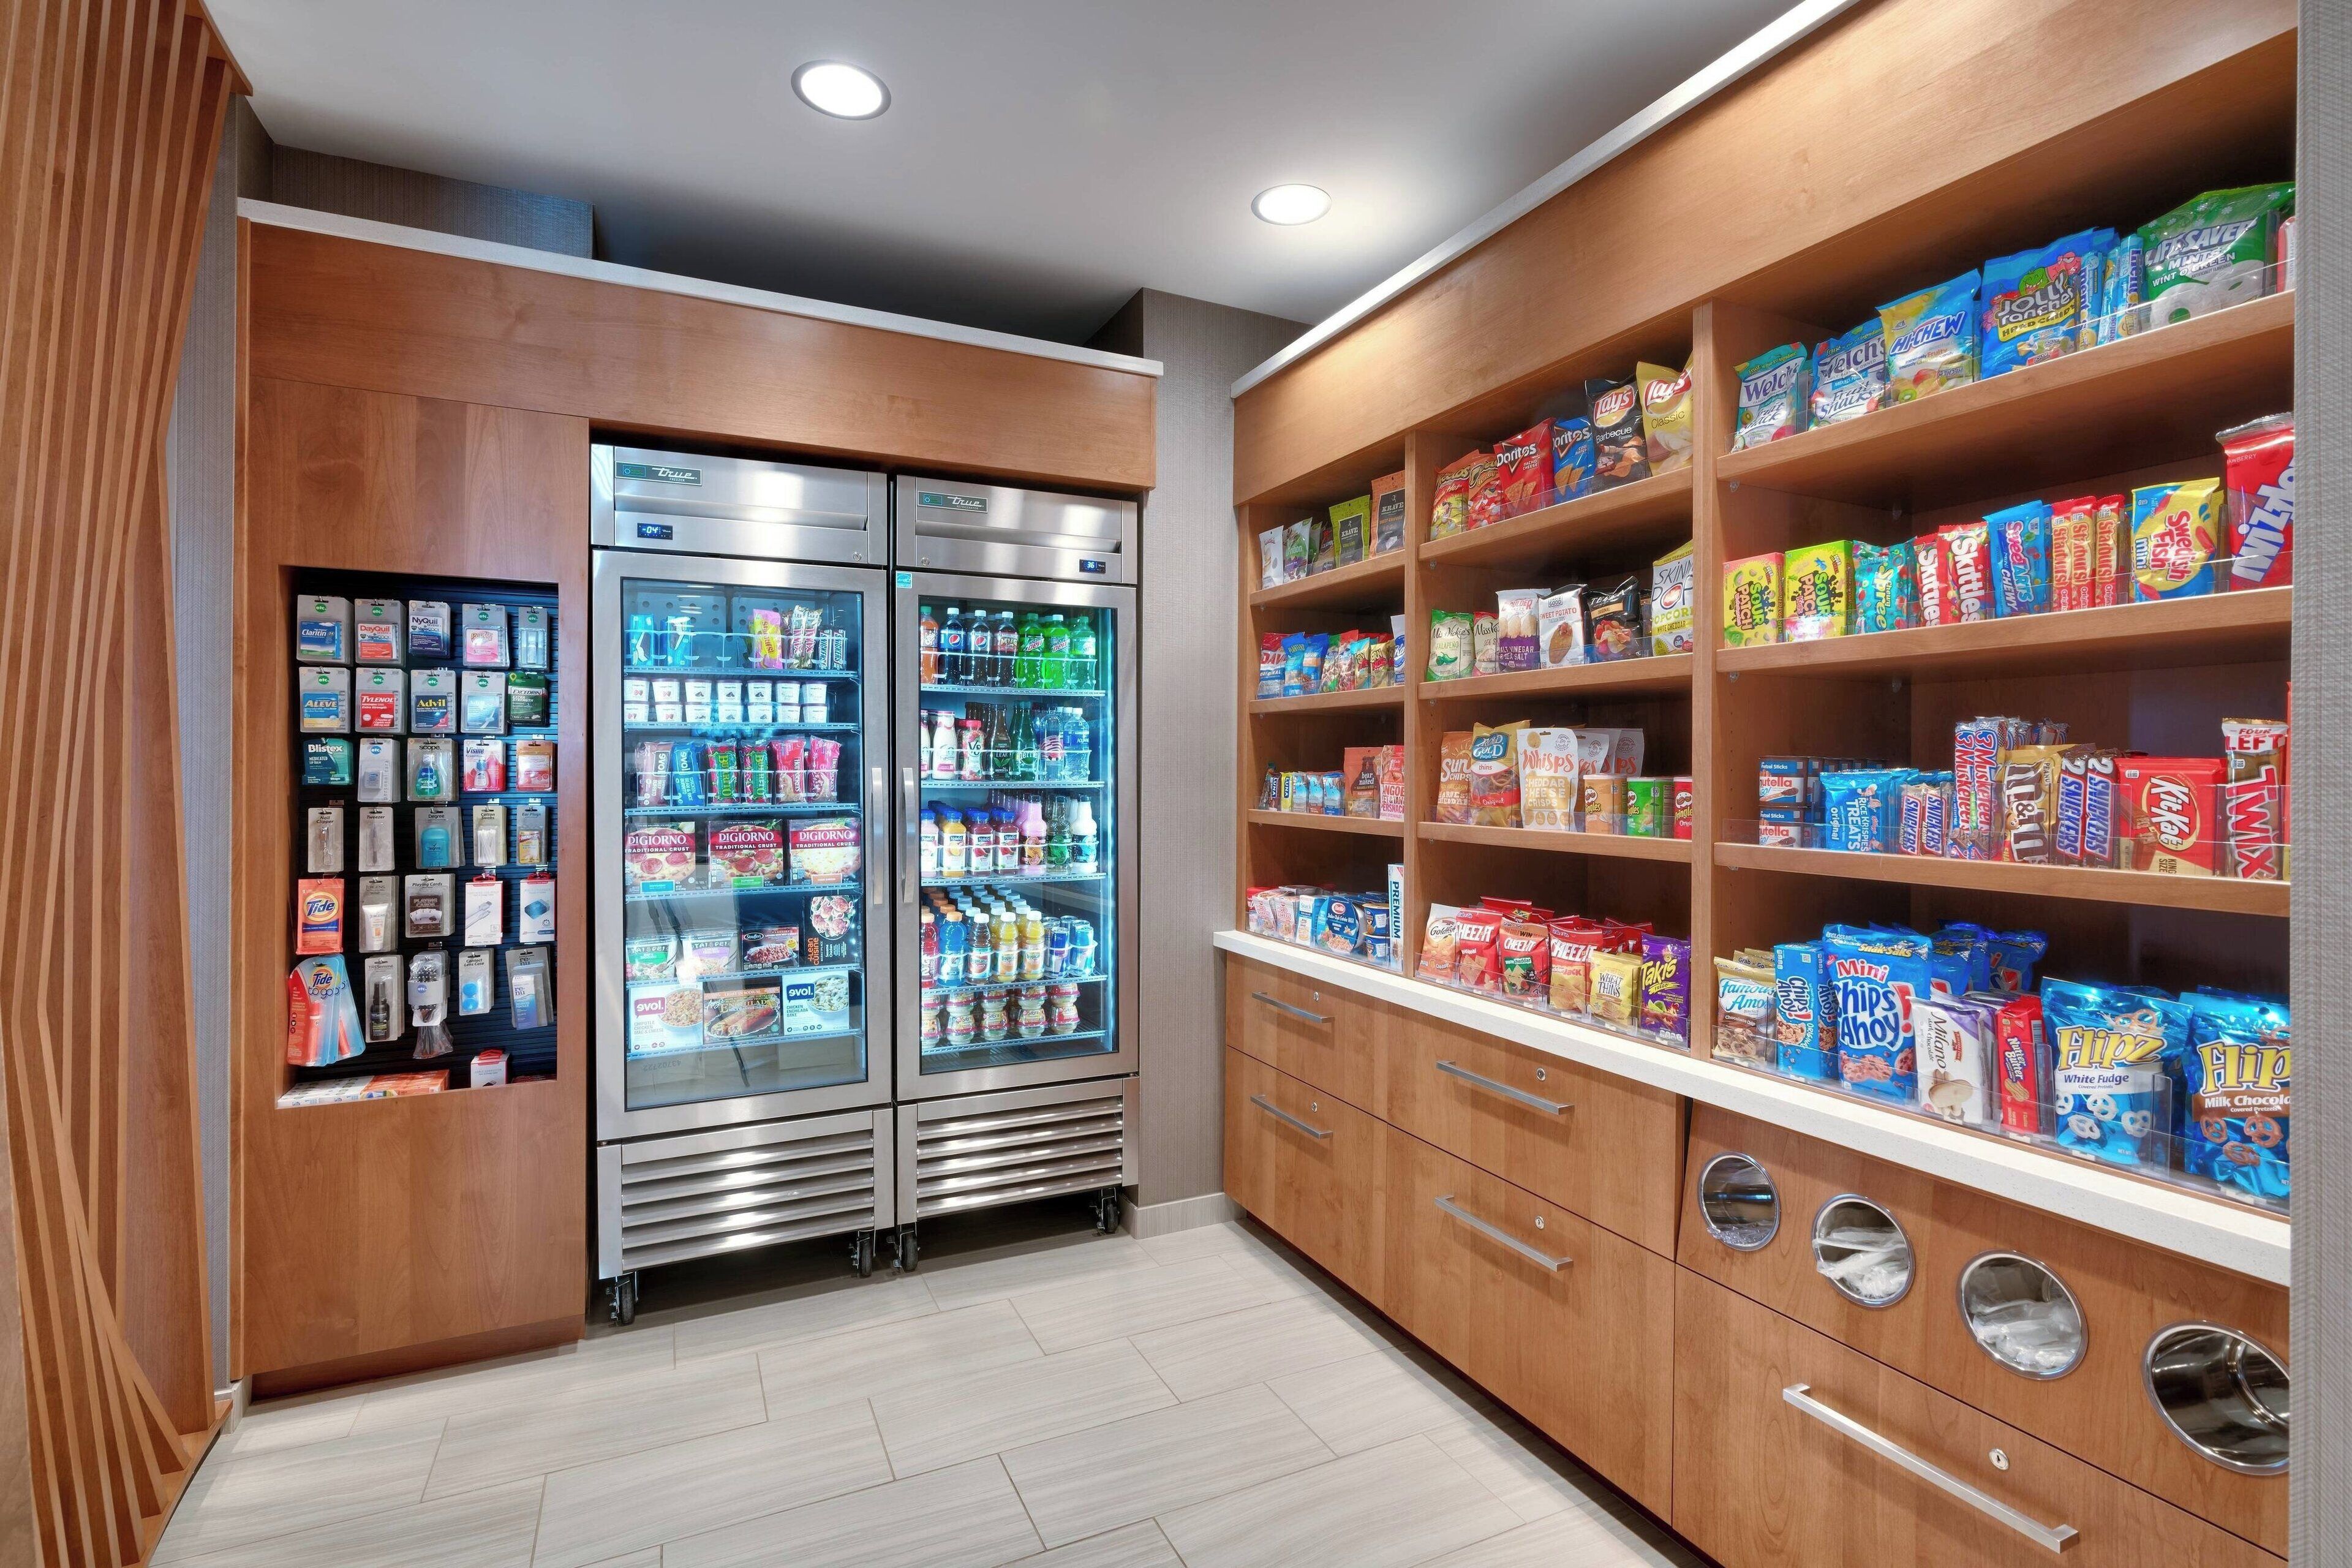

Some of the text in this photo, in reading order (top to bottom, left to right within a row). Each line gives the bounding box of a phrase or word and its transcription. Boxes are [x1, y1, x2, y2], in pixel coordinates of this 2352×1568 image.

[2153, 268, 2188, 287] WINT O
[1999, 272, 2065, 316] JOLLY
[1890, 311, 1967, 355] HI-CHEW
[1820, 337, 1886, 379] Welch's
[1833, 380, 1870, 402] Fruit
[1595, 391, 1632, 420] Lay's
[1651, 411, 1685, 429] Classic
[1596, 427, 1632, 444] Barbecue
[1496, 443, 1536, 467] Doritos
[1382, 502, 1404, 512] KRAVE
[1341, 527, 1358, 537] KRAVE
[2136, 538, 2149, 570] mini
[2150, 527, 2171, 570] Fish
[2166, 510, 2192, 582] Swedish
[1950, 537, 1981, 623] Skittles
[2001, 568, 2019, 611] CHEWY
[1736, 584, 1754, 630] PATCH
[1750, 582, 1765, 626] SOUR
[412, 617, 438, 625] NyQuil
[1540, 611, 1555, 620] SWEET
[1555, 608, 1577, 617] POTATO
[360, 625, 390, 633] DayQuil
[1447, 624, 1471, 638] Vickie's
[1667, 620, 1686, 630] CHEDDAR
[968, 740, 981, 755] V8
[1955, 733, 1974, 748] 3
[1975, 732, 1994, 748] 3
[2226, 734, 2286, 751] LEFT
[308, 744, 344, 754] Blistex
[1473, 744, 1503, 758] GOLD
[1522, 749, 1575, 774] Whisps
[2088, 757, 2113, 774] 2
[1525, 778, 1564, 788] CHEDDAR
[1759, 777, 1793, 788] nutella
[1525, 788, 1566, 799] CHEESE
[1528, 799, 1557, 807] CRISPS
[2150, 777, 2191, 845] Kit Kat
[1926, 795, 1942, 852] SNICKERS
[2058, 775, 2083, 856] SNICKERS
[2086, 774, 2112, 857] SNICKERS
[2226, 765, 2279, 879] TWIX
[1846, 799, 1861, 851] TREATS
[1903, 796, 1919, 853] SNICKERS
[719, 832, 774, 843] DIGIORNO
[1860, 816, 1869, 852] KRISPIES
[2159, 858, 2168, 873] SIZE
[2167, 858, 2177, 875] KING
[306, 900, 335, 917] Tide
[1392, 881, 1401, 939] PREMIUM
[1430, 925, 1457, 936] Goldfish
[1504, 938, 1537, 952] CHEEZ-IT
[1738, 956, 1751, 965] Grab
[1641, 959, 1678, 990] Takis
[1837, 959, 1890, 982] Mini
[312, 973, 333, 987] Tide
[1599, 973, 1624, 986] WHEAT
[1598, 982, 1621, 998] THINS
[1719, 981, 1776, 998] Famous
[1788, 975, 1809, 1016] Chips
[1726, 995, 1768, 1011] Amos
[1725, 1014, 1747, 1023] Chocolate
[1931, 1011, 1949, 1069] Milano
[2056, 1026, 2167, 1071] Flipz
[2007, 1037, 2026, 1067] Nutter
[2004, 1052, 2023, 1080] Butter
[2198, 1042, 2291, 1096] Flip
[2064, 1074, 2130, 1085] White Fudge
[2205, 1097, 2231, 1108] Milk
